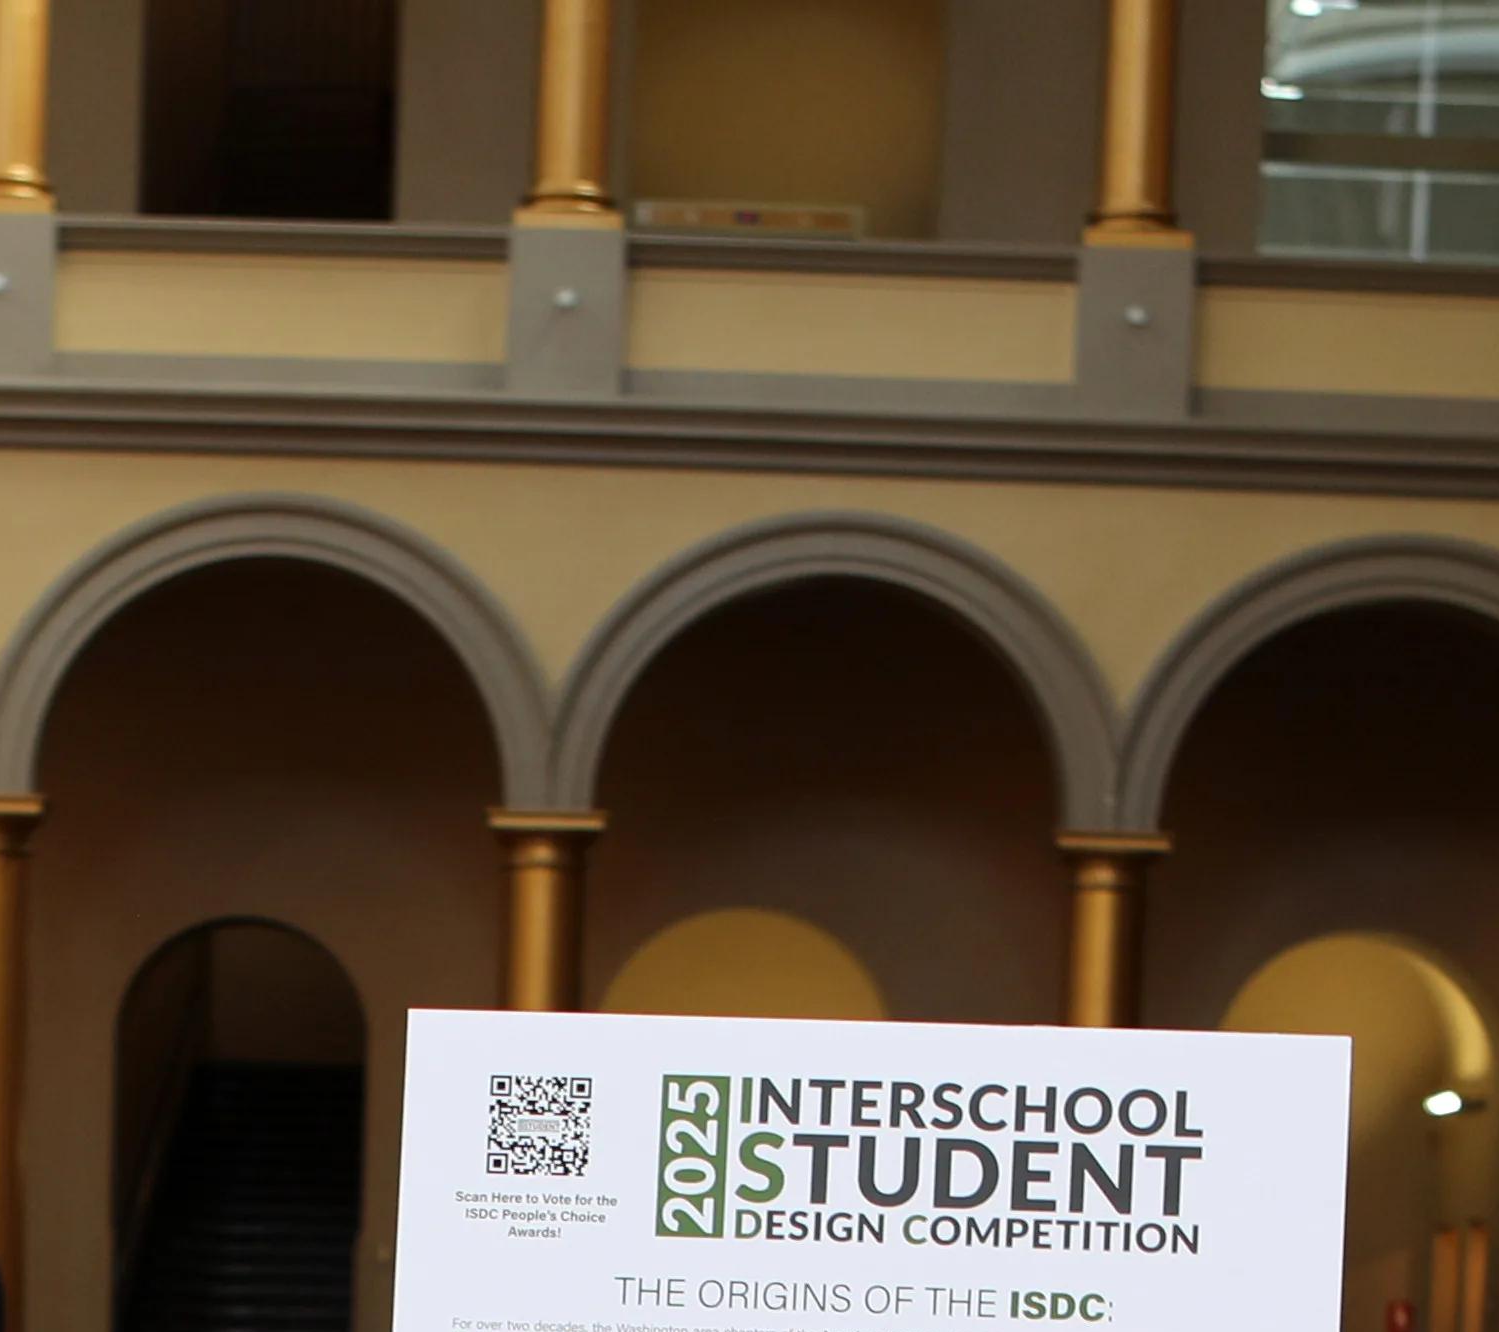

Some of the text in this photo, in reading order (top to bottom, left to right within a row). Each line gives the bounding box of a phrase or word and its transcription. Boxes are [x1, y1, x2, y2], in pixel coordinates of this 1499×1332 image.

[739, 1076, 1203, 1138] INTERSCHOOL
[662, 1081, 720, 1234] 2025
[734, 1130, 1203, 1217] STUDENT
[454, 1190, 618, 1207] Scan Here to Vote for the
[465, 1207, 499, 1220] ISDC
[560, 1210, 606, 1223] Choice
[507, 1225, 561, 1238] Awards!
[734, 1208, 1199, 1255] DESIGN COMPETITION
[613, 1276, 1113, 1322] THE ORIGINS OF THE ISDC:
